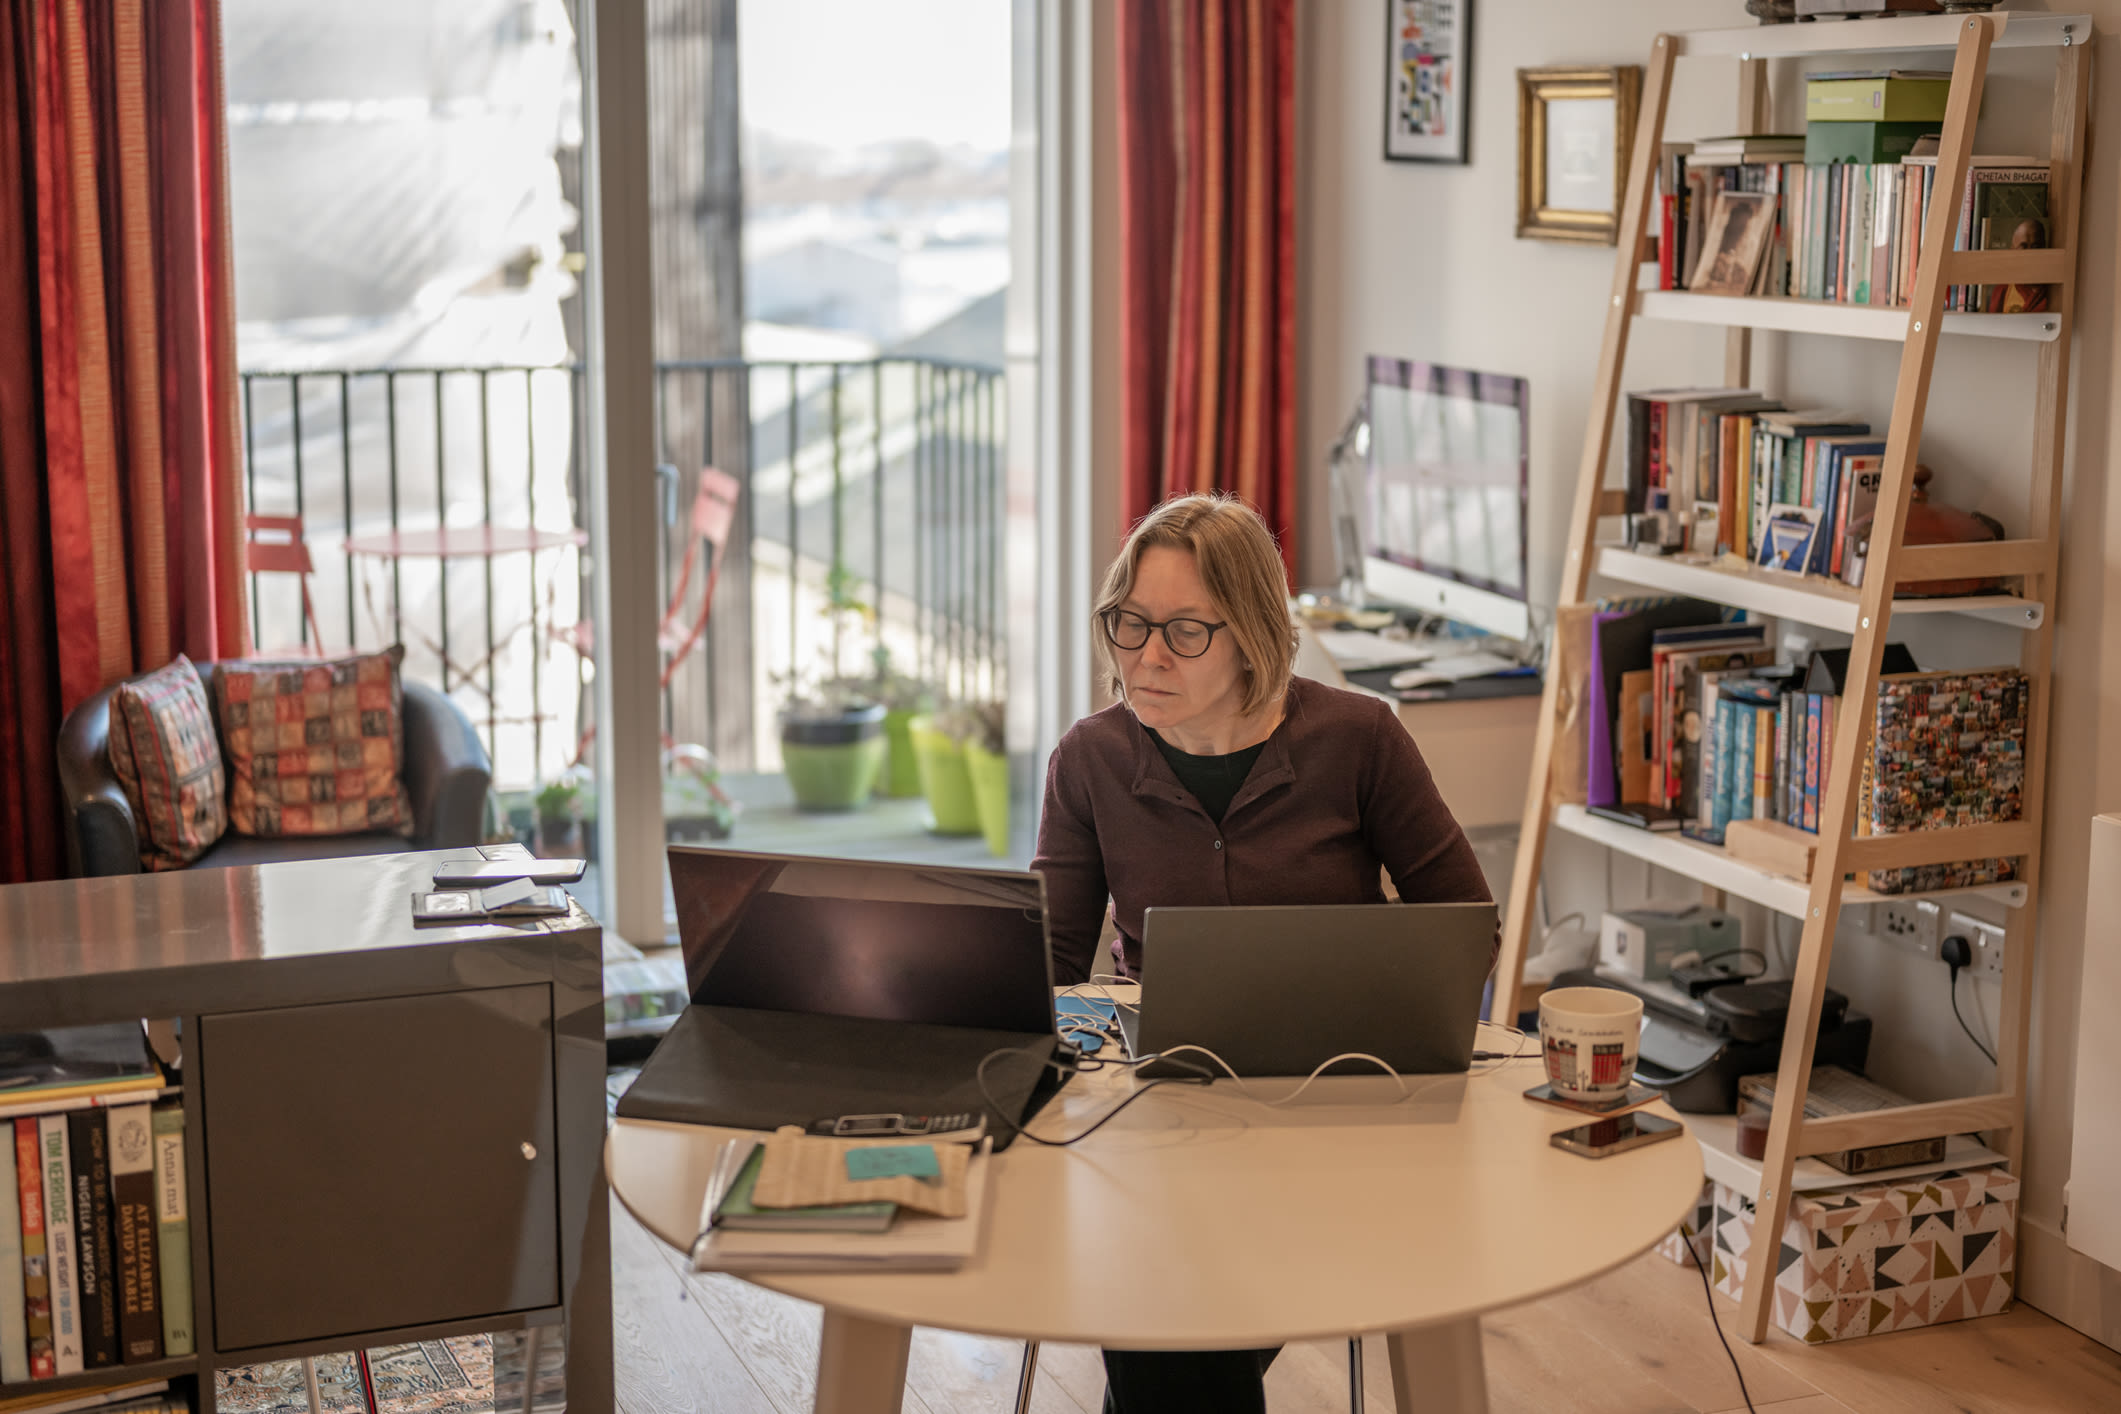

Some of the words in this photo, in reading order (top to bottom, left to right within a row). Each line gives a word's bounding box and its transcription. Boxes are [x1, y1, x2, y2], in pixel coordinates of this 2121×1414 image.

[1976, 172, 2010, 181] CHETAN
[2013, 173, 2048, 182] BHAGAT
[46, 1129, 63, 1158] TOM
[163, 1139, 179, 1186] Annas
[25, 1192, 40, 1227] India
[48, 1161, 68, 1226] KERRIDGE
[78, 1175, 92, 1231] NIGELLA
[137, 1203, 150, 1223] AT
[121, 1204, 137, 1264] DAVID'S
[57, 1256, 70, 1288] WEIGHT
[81, 1235, 97, 1294] LAWSON
[138, 1227, 154, 1312] ELIZABETH
[124, 1267, 139, 1314] TABLE
